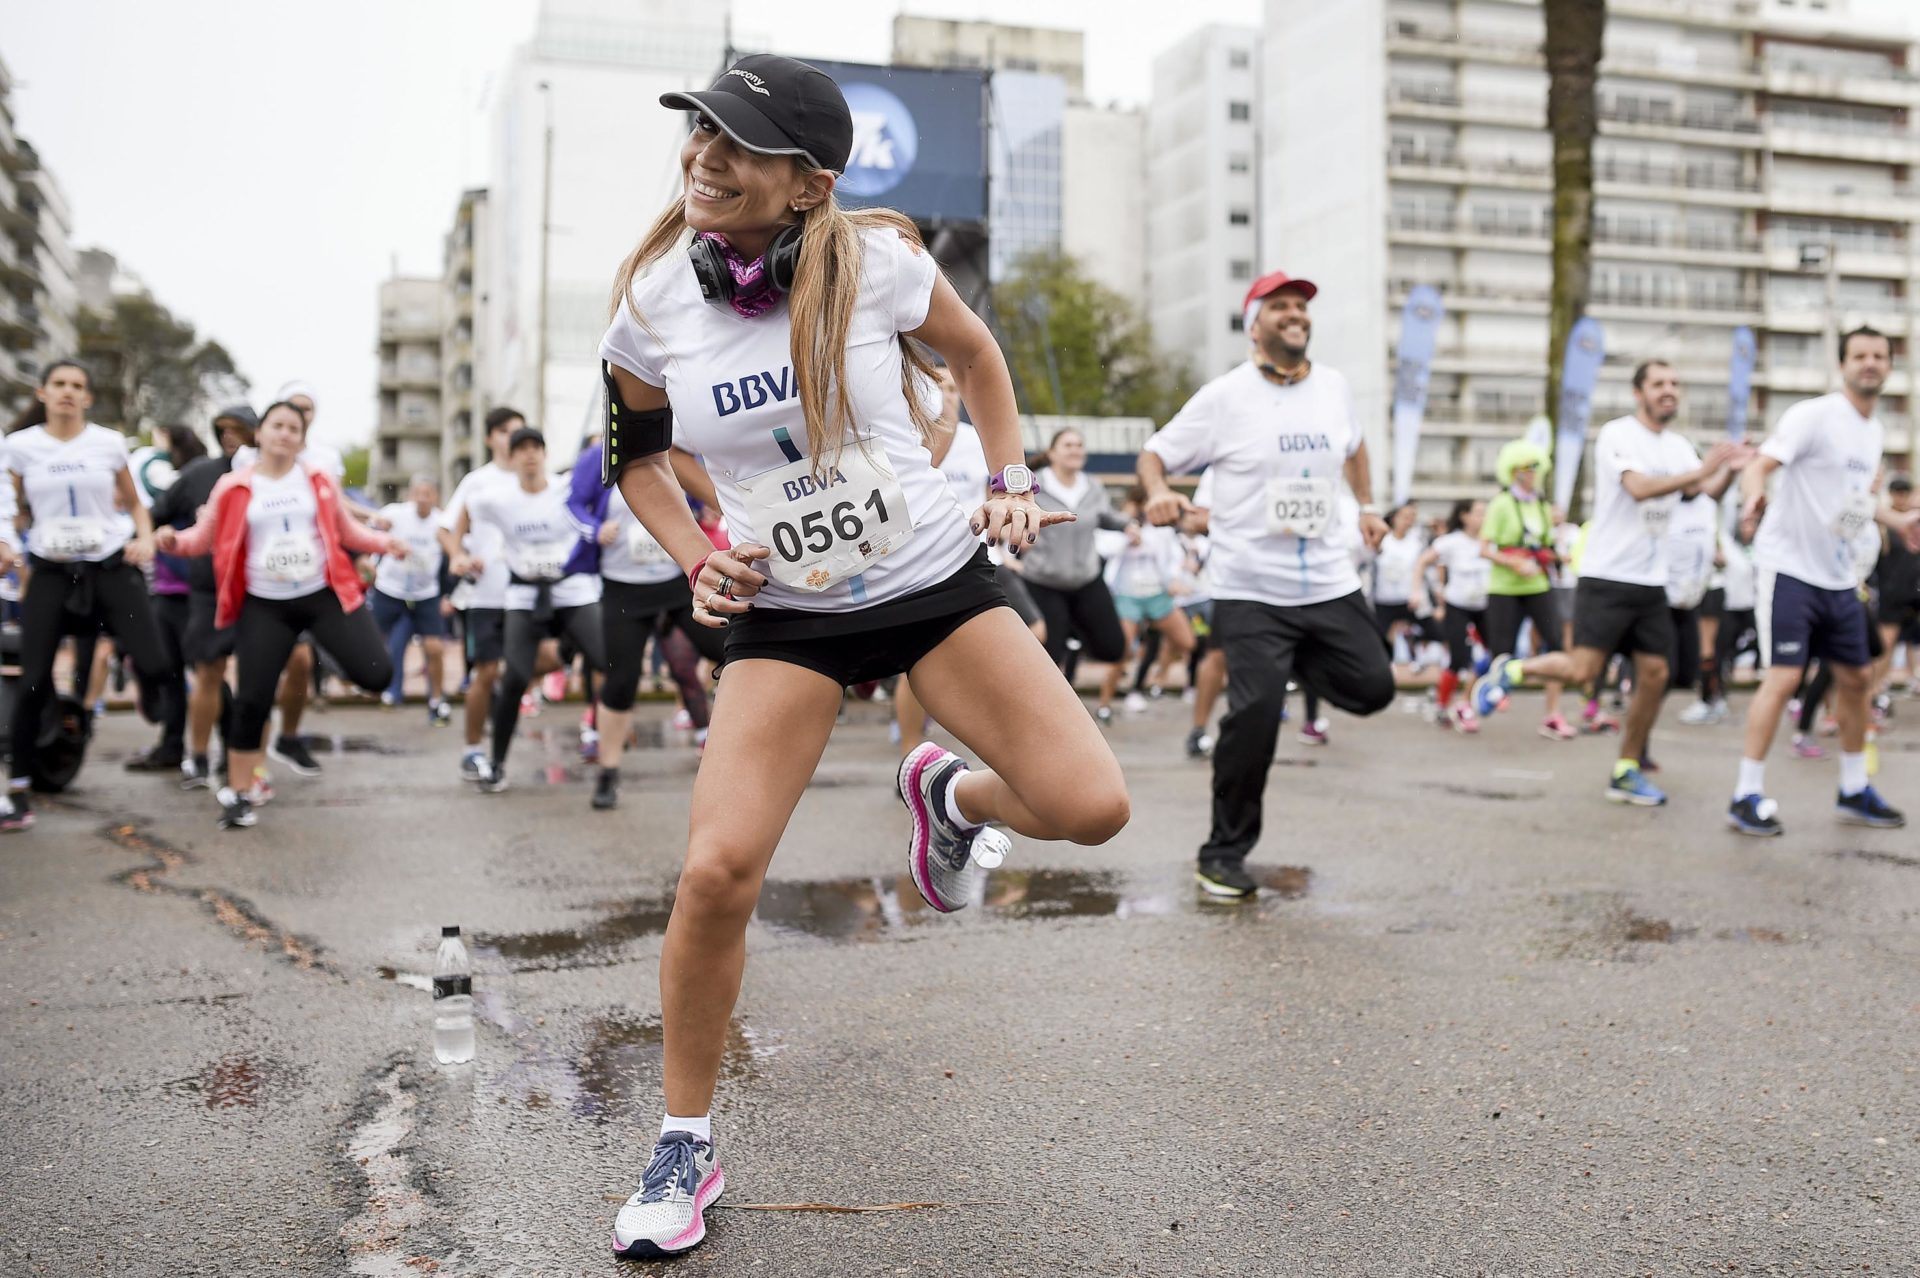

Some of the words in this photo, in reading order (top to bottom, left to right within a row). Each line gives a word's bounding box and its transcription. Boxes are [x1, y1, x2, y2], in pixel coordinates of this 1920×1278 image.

[1279, 433, 1331, 453] BBVA
[783, 466, 848, 501] BBVA
[1275, 500, 1327, 520] 0236
[772, 488, 888, 562] 0561
